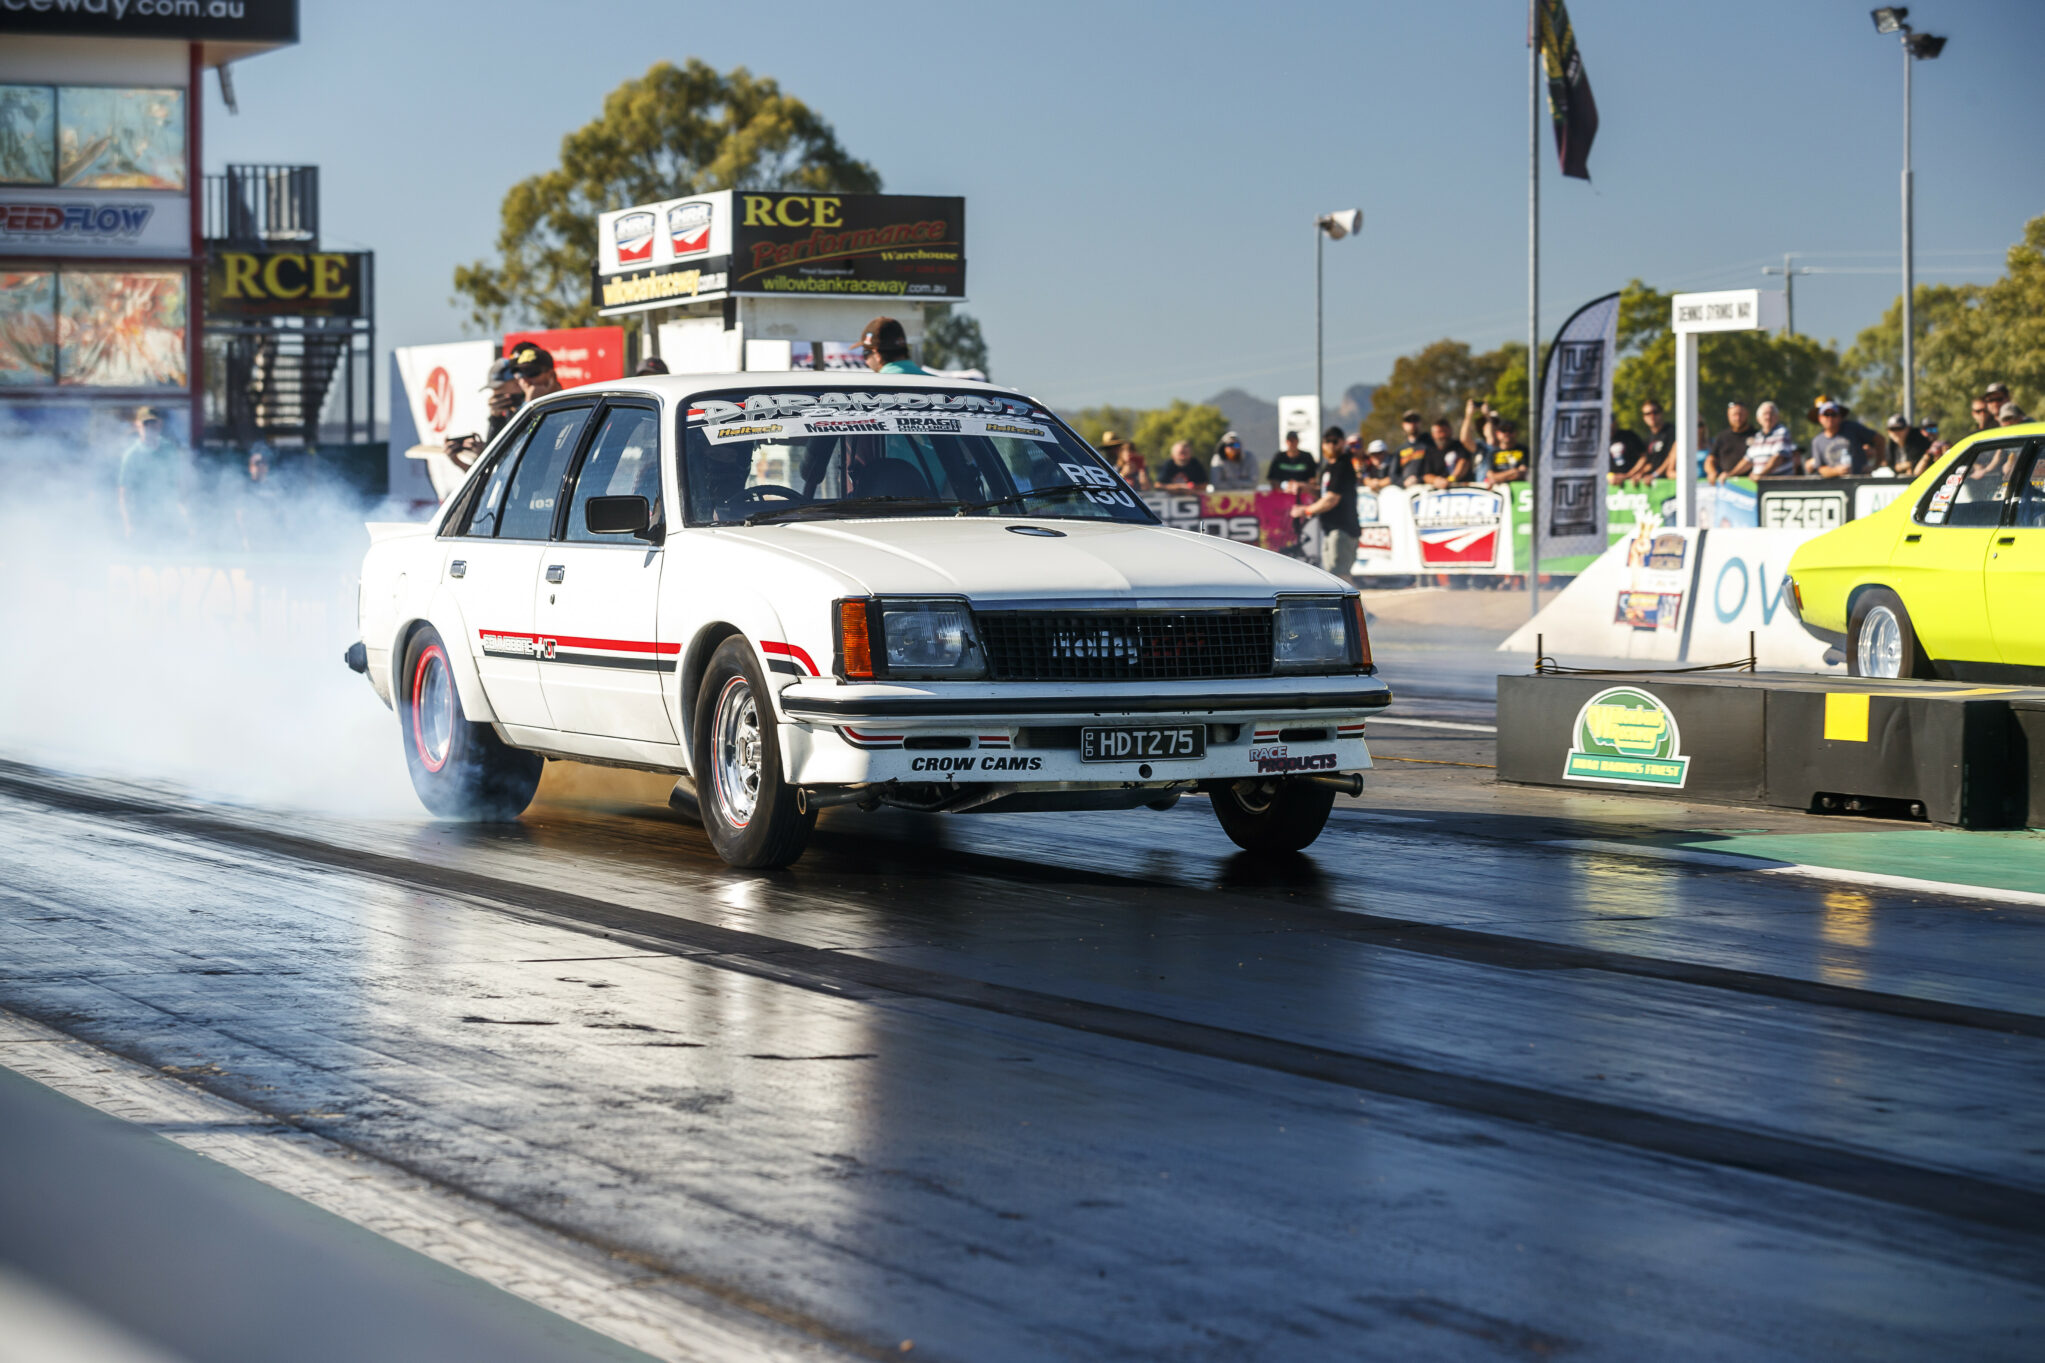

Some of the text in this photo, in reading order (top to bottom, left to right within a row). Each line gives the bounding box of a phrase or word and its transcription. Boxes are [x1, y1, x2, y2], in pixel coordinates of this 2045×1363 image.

[742, 196, 843, 227] RCE
[751, 220, 946, 269] Performance
[880, 250, 958, 261] Warehouse
[222, 253, 351, 298] RCE
[718, 417, 1045, 439] Haltech MACHINE DRAG Haltech
[835, 418, 877, 428] Street
[1058, 462, 1118, 487] RB
[1100, 730, 1194, 757] HDT275
[1250, 746, 1288, 761] RACE
[911, 757, 1042, 771] CROW CAMS
[1257, 754, 1337, 773] PRODUCTS
